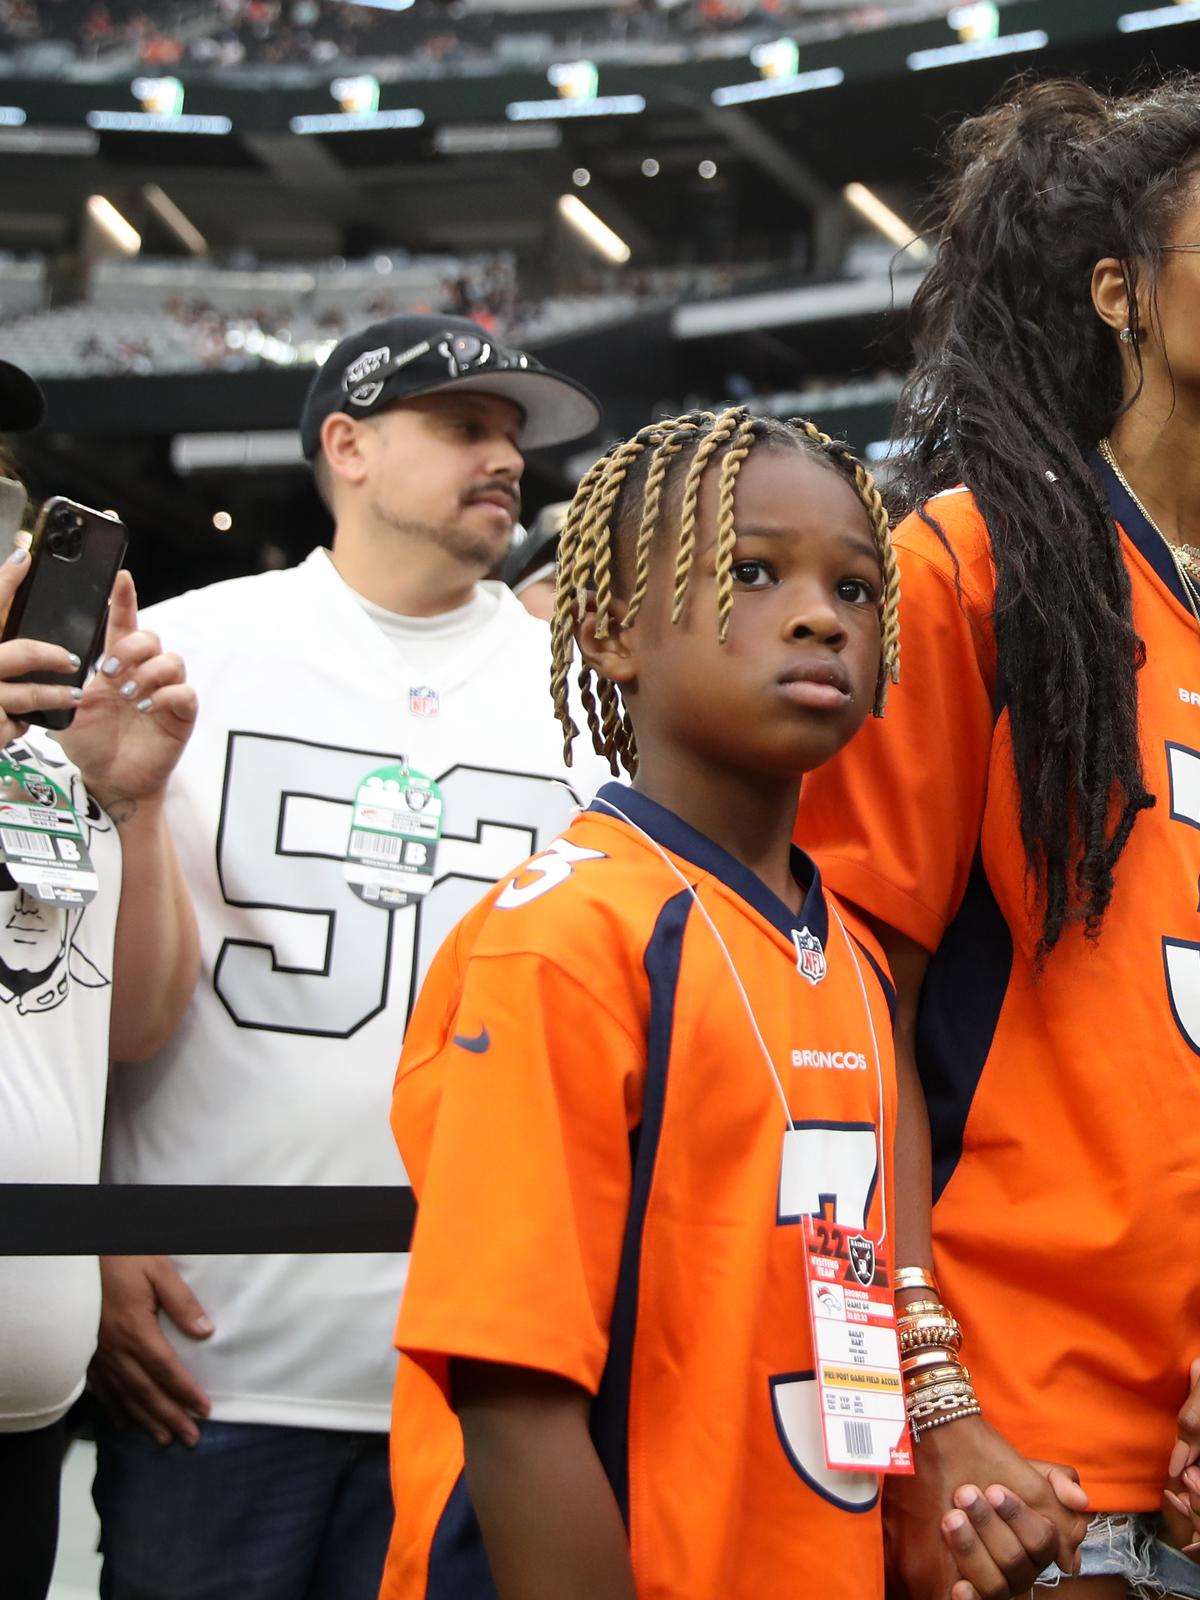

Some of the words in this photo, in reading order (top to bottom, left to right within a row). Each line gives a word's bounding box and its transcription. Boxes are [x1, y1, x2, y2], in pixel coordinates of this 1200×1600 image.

[56, 837, 81, 862] B
[404, 841, 427, 866] B
[803, 950, 825, 976] NFL
[792, 1049, 868, 1070] BRONCOS
